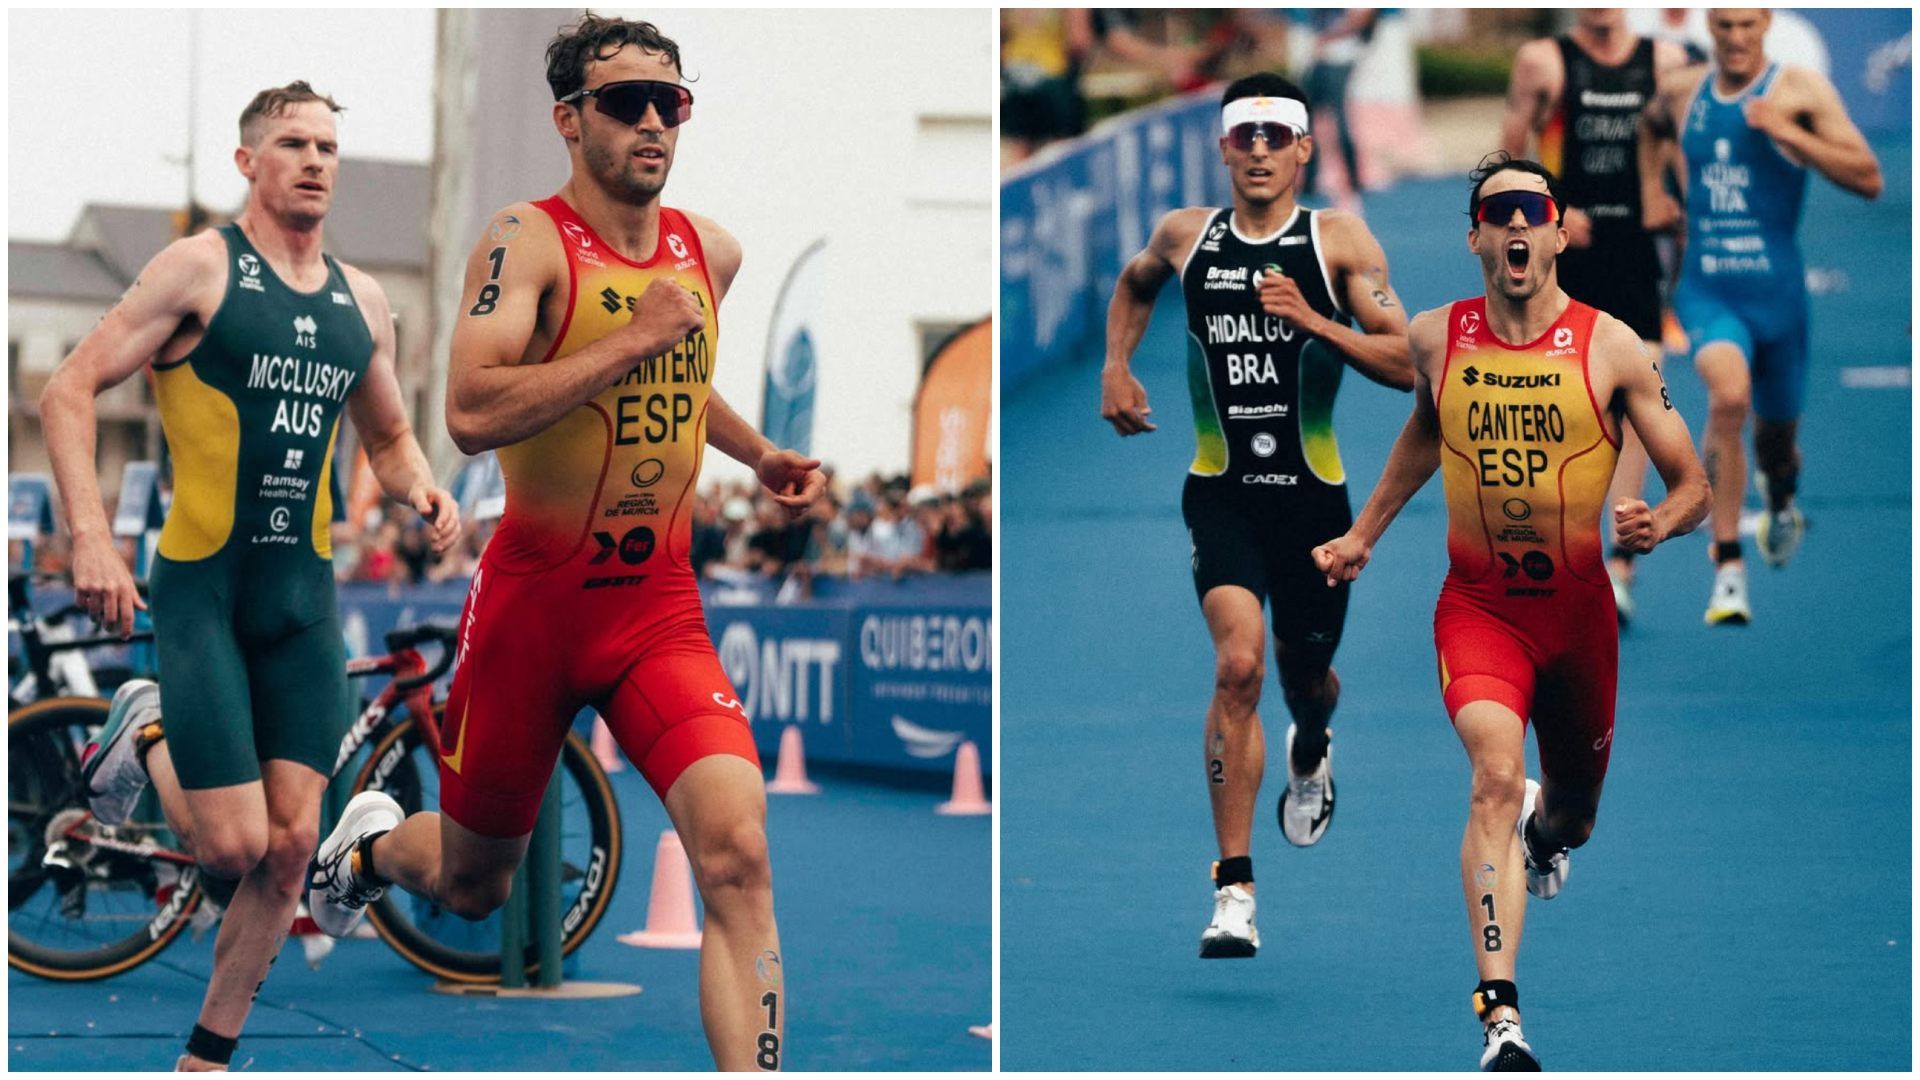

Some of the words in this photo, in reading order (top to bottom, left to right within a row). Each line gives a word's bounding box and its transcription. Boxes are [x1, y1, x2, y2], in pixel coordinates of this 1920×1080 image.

[469, 246, 507, 317] 18
[1204, 280, 1246, 291] triathlon
[1206, 266, 1248, 281] Brasil
[1372, 290, 1396, 308] 2
[295, 335, 317, 349] AIS
[613, 331, 708, 387] ANTERO
[1227, 353, 1279, 386] BRA
[247, 353, 356, 402] MCCLUSKY
[1483, 372, 1561, 388] SUZUKI
[270, 399, 323, 438] AUS
[615, 393, 693, 446] ESP
[1228, 403, 1288, 415] Bianchi
[1468, 401, 1565, 443] CANTERO
[262, 474, 310, 491] Ramsay
[1242, 474, 1298, 485] CADEX
[1478, 449, 1548, 488] ESP
[259, 488, 288, 498] Health
[289, 490, 307, 500] Care
[252, 535, 298, 545] LAPPED
[760, 637, 840, 724] NTT
[1210, 759, 1225, 784] 2
[1480, 893, 1502, 952] 18
[756, 990, 779, 1071] 18
